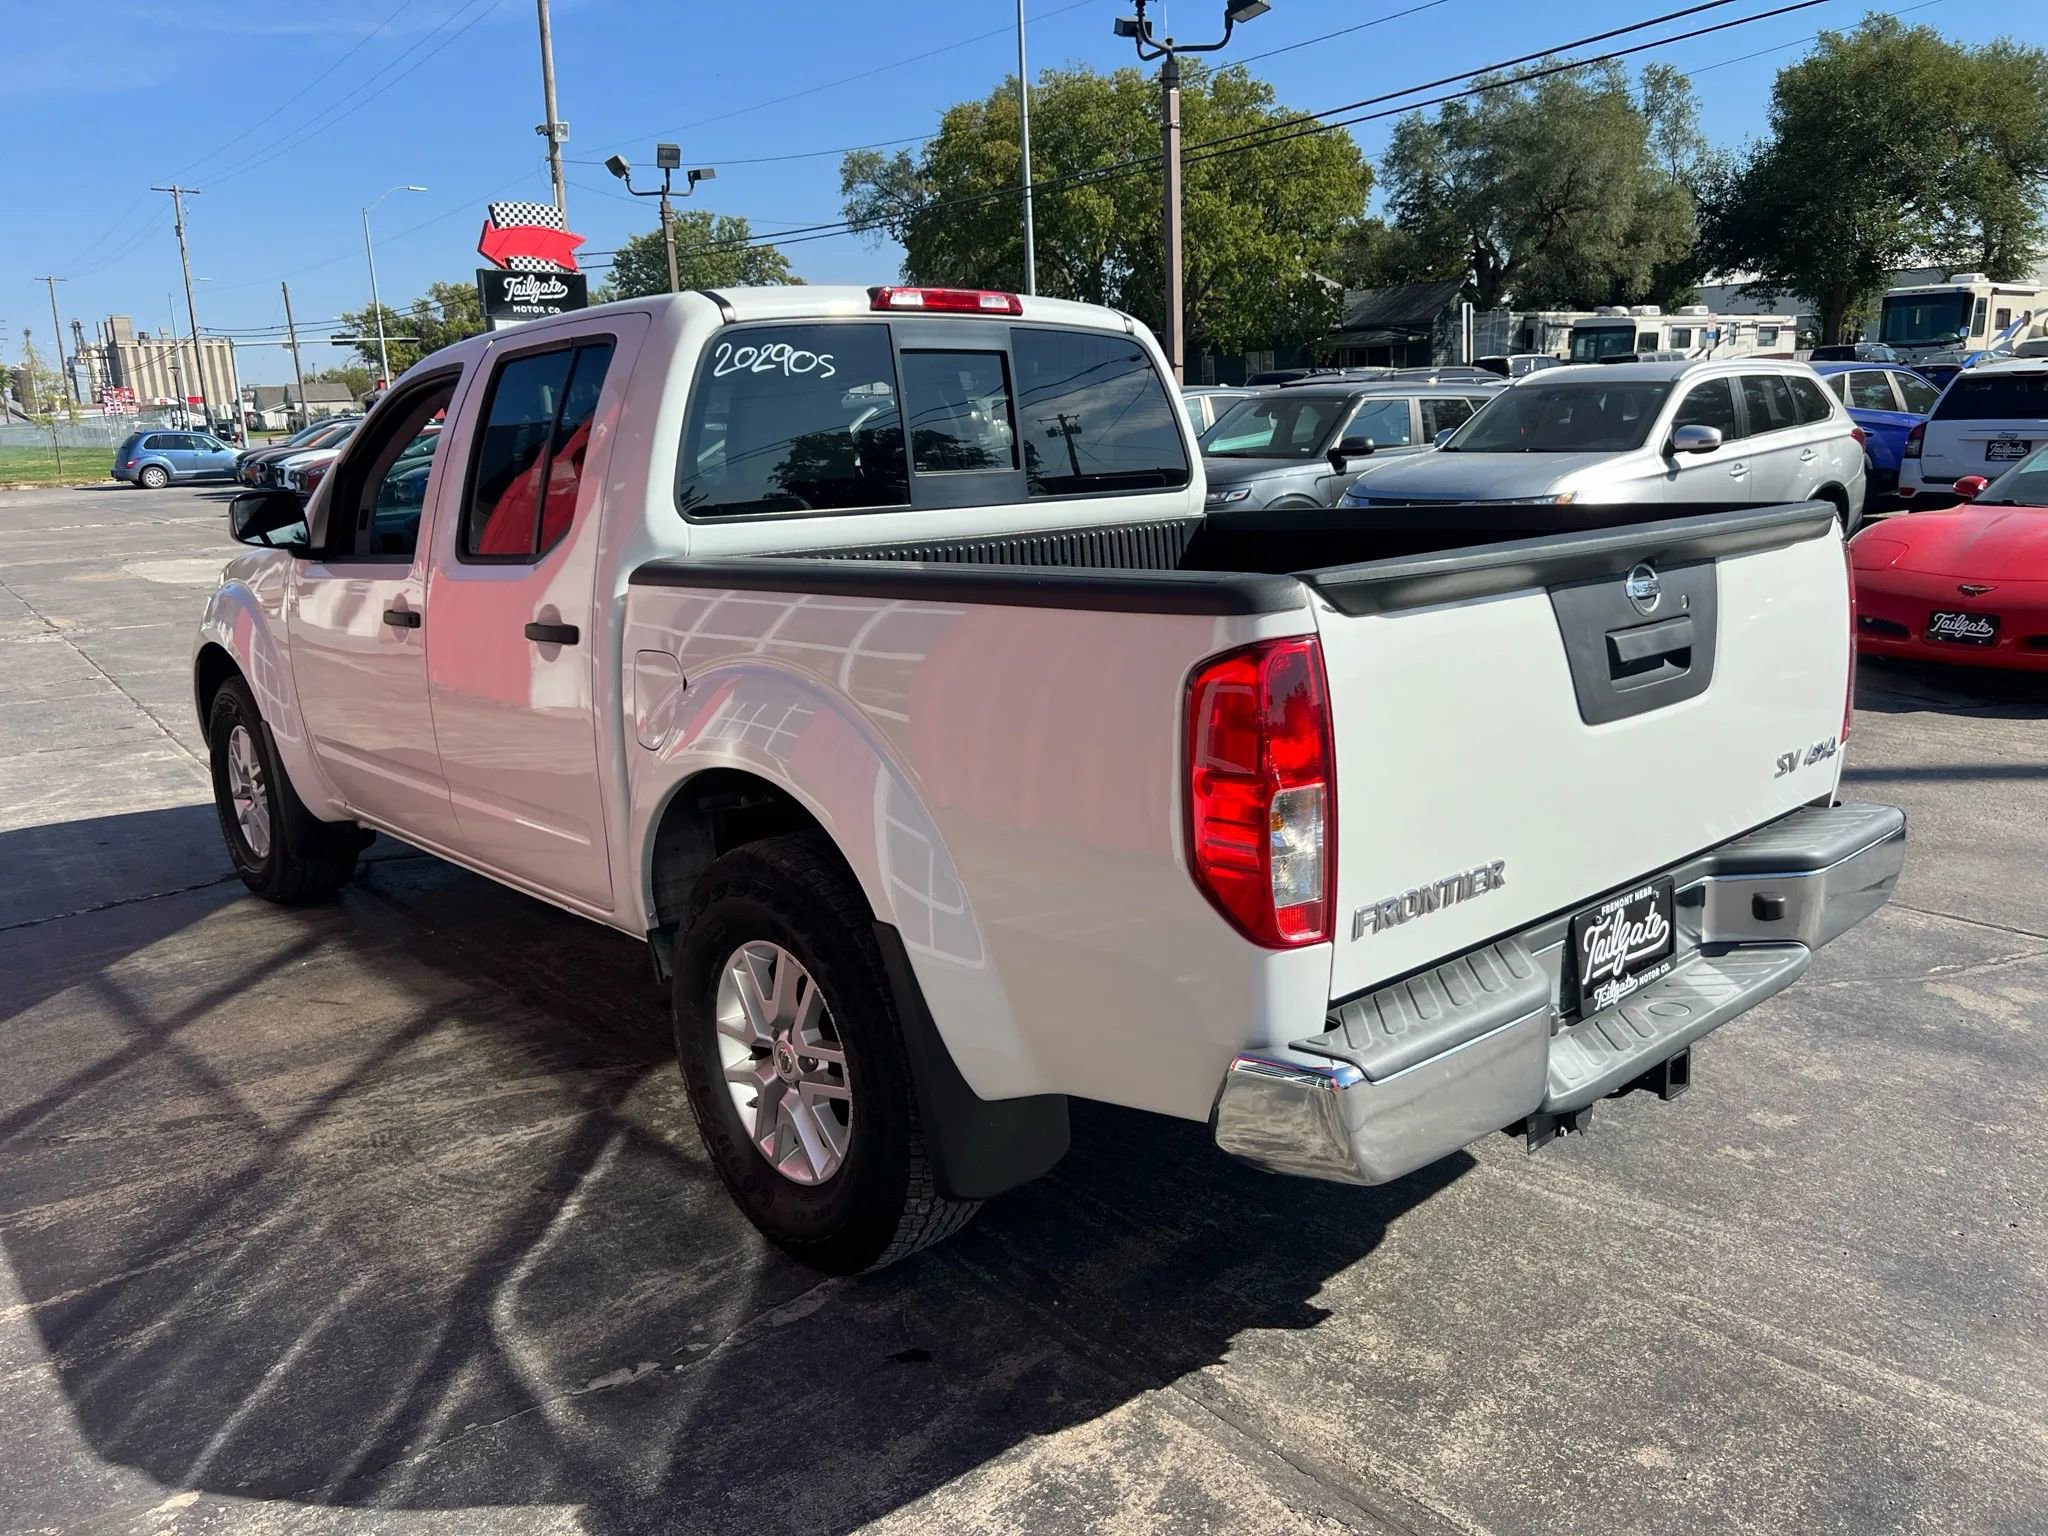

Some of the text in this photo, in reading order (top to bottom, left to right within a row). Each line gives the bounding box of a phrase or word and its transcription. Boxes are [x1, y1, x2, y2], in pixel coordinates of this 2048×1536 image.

[503, 274, 568, 304] Tailgate
[512, 305, 546, 314] MOTOR
[1930, 612, 1994, 638] Tailgate
[1774, 748, 1802, 779] SV
[1350, 857, 1506, 943] FRONTIER
[1601, 892, 1634, 916] FREMONT
[1582, 901, 1670, 986] Tailgate
[1594, 973, 1639, 1011] Tailgate
[1639, 968, 1660, 986] MOTOR
